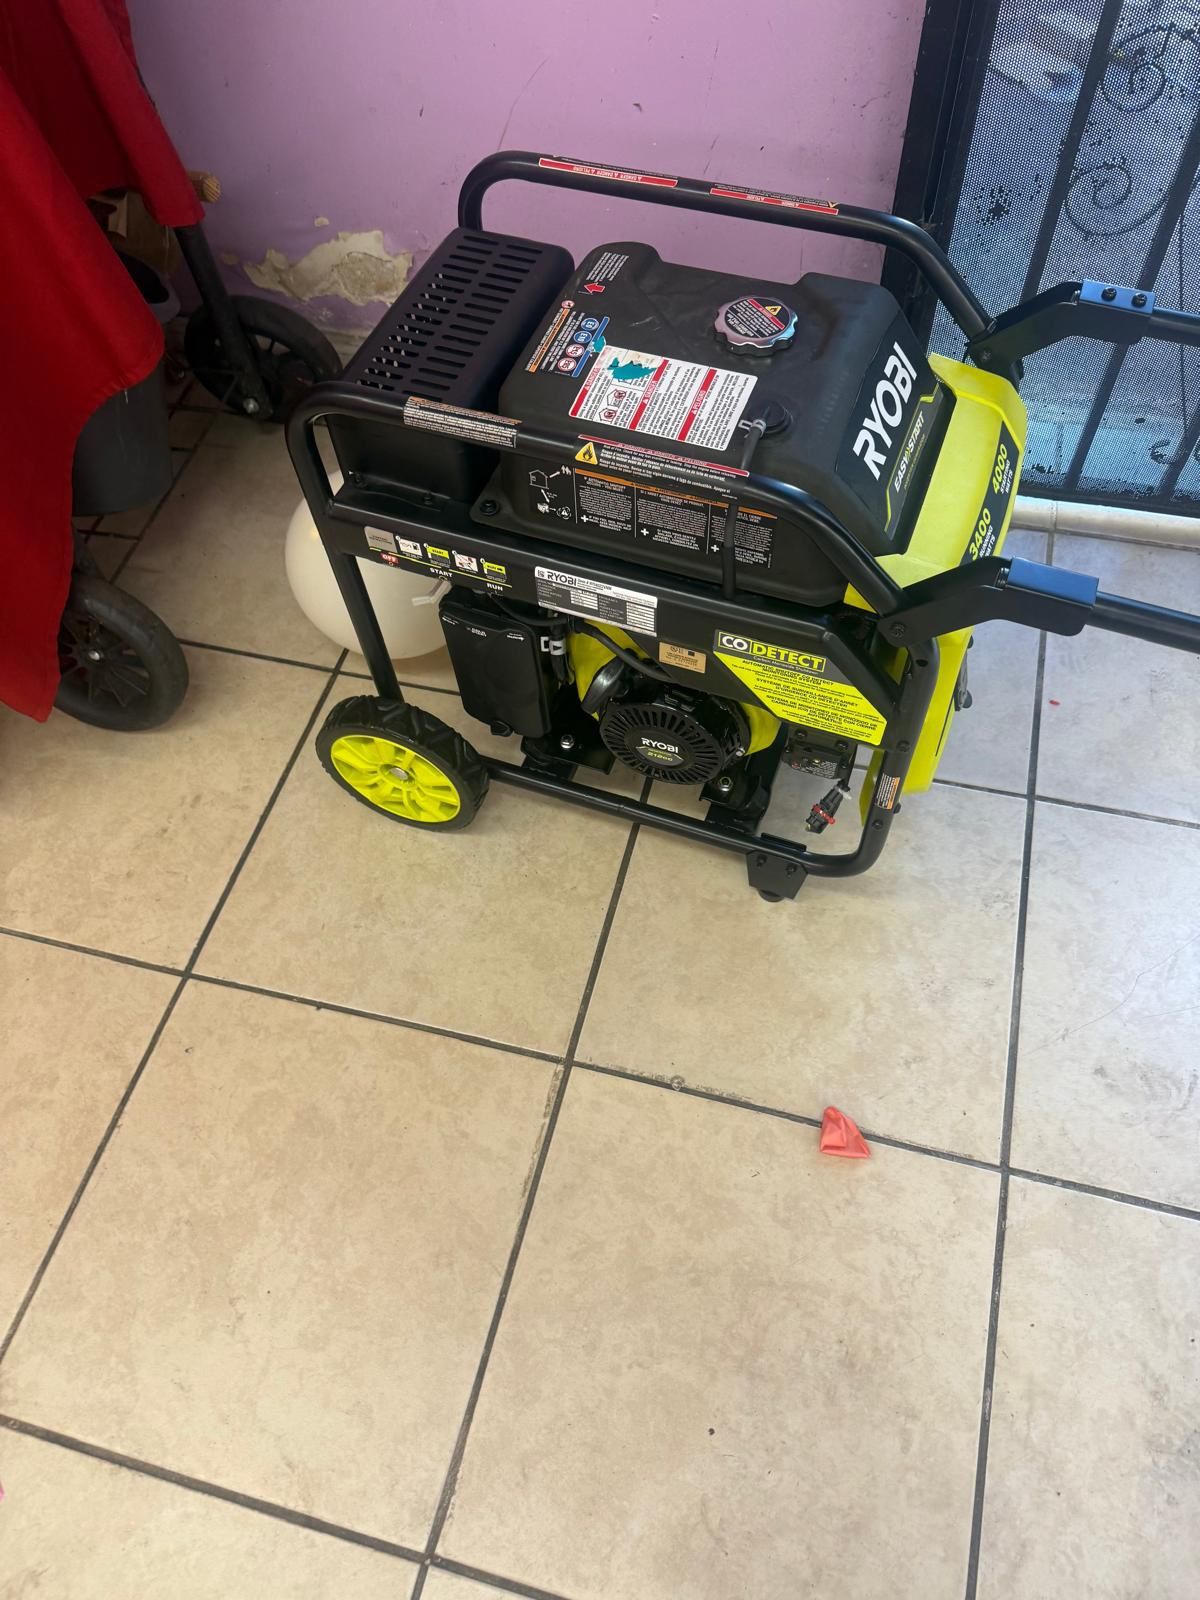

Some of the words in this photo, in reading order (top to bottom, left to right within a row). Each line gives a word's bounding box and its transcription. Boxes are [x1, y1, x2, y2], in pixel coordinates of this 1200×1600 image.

[852, 341, 918, 481] RYOBI
[992, 444, 1008, 495] 4000
[969, 508, 991, 560] 3400
[381, 553, 396, 562] OFF
[428, 567, 453, 577] START
[546, 571, 577, 586] RYOBI
[485, 582, 503, 591] RUN
[721, 635, 748, 651] CO
[752, 643, 823, 670] DETECT
[641, 737, 679, 754] RYOBI
